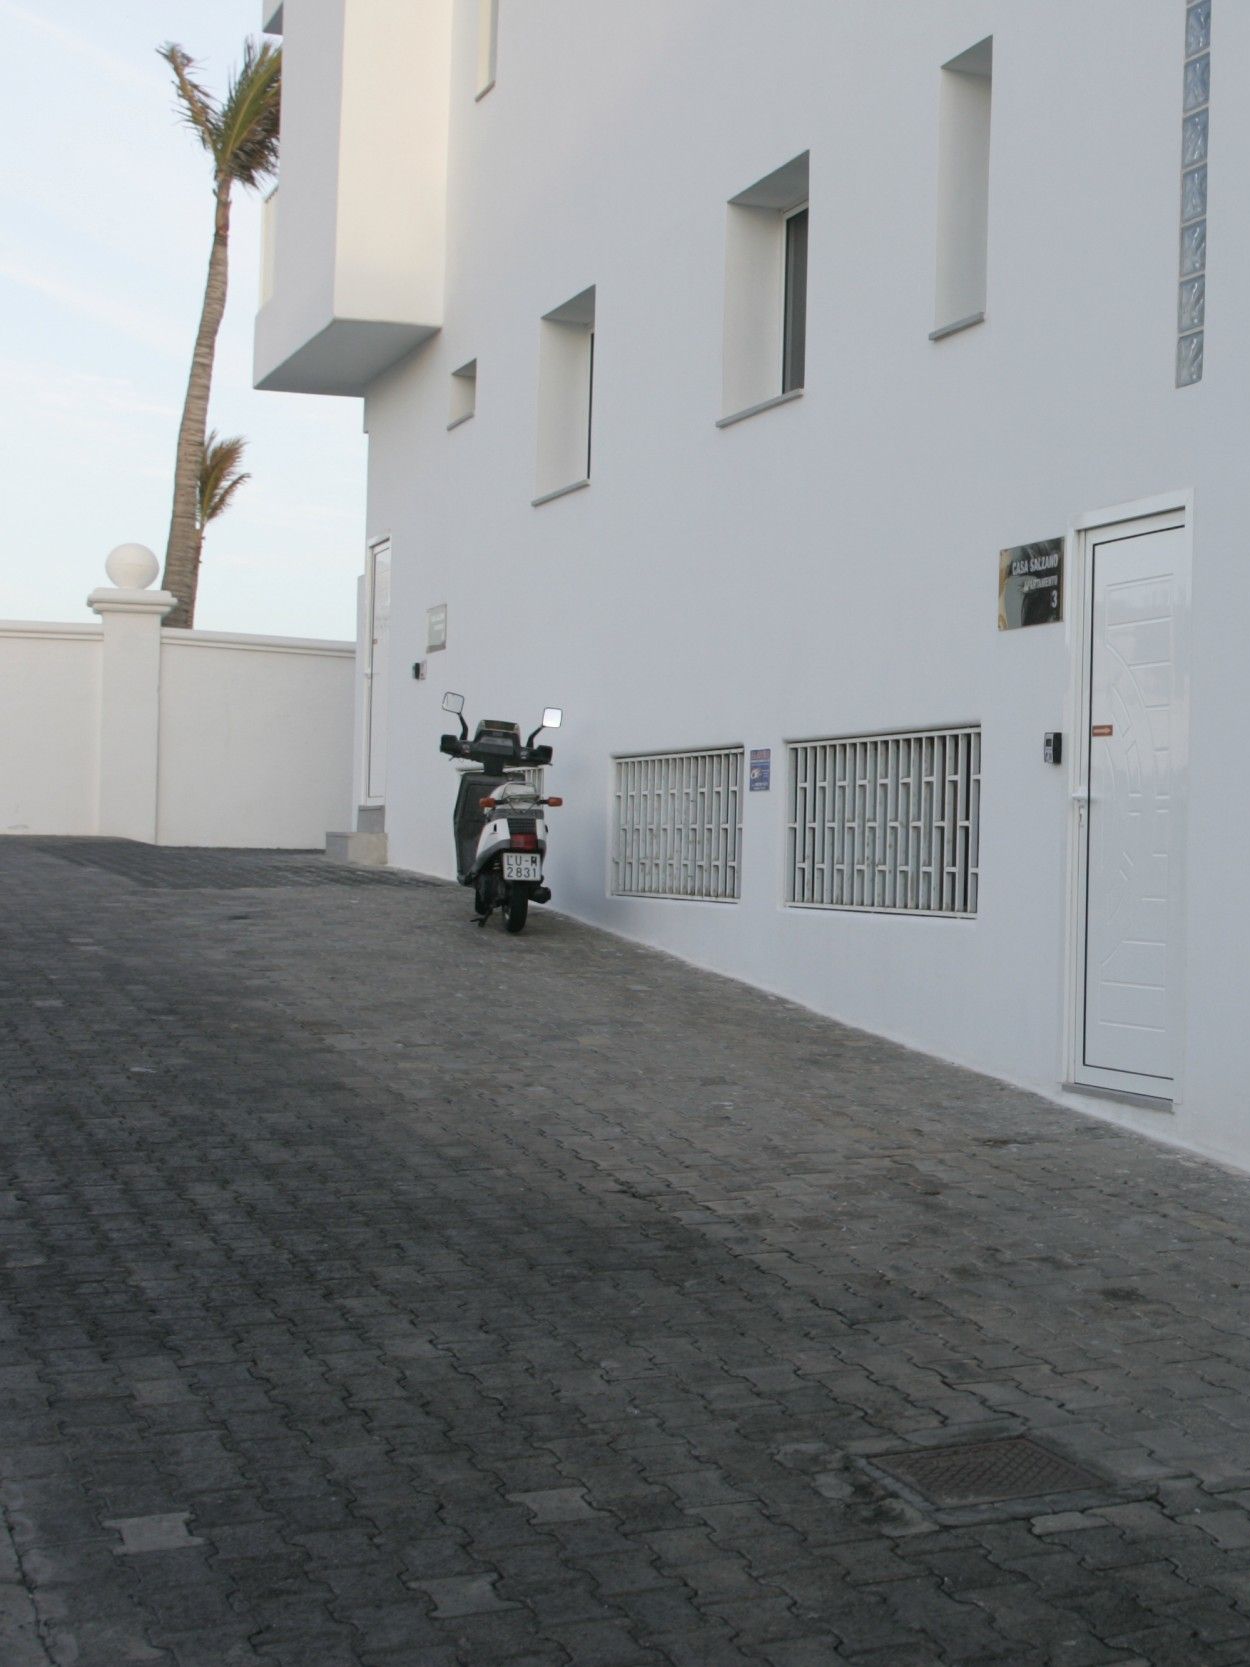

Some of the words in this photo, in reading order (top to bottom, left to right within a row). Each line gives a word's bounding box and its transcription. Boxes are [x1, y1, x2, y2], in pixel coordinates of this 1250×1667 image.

[1012, 560, 1029, 576] CASA
[1029, 553, 1059, 572] SALZANO
[1051, 590, 1058, 609] 3
[506, 867, 537, 878] 2831
